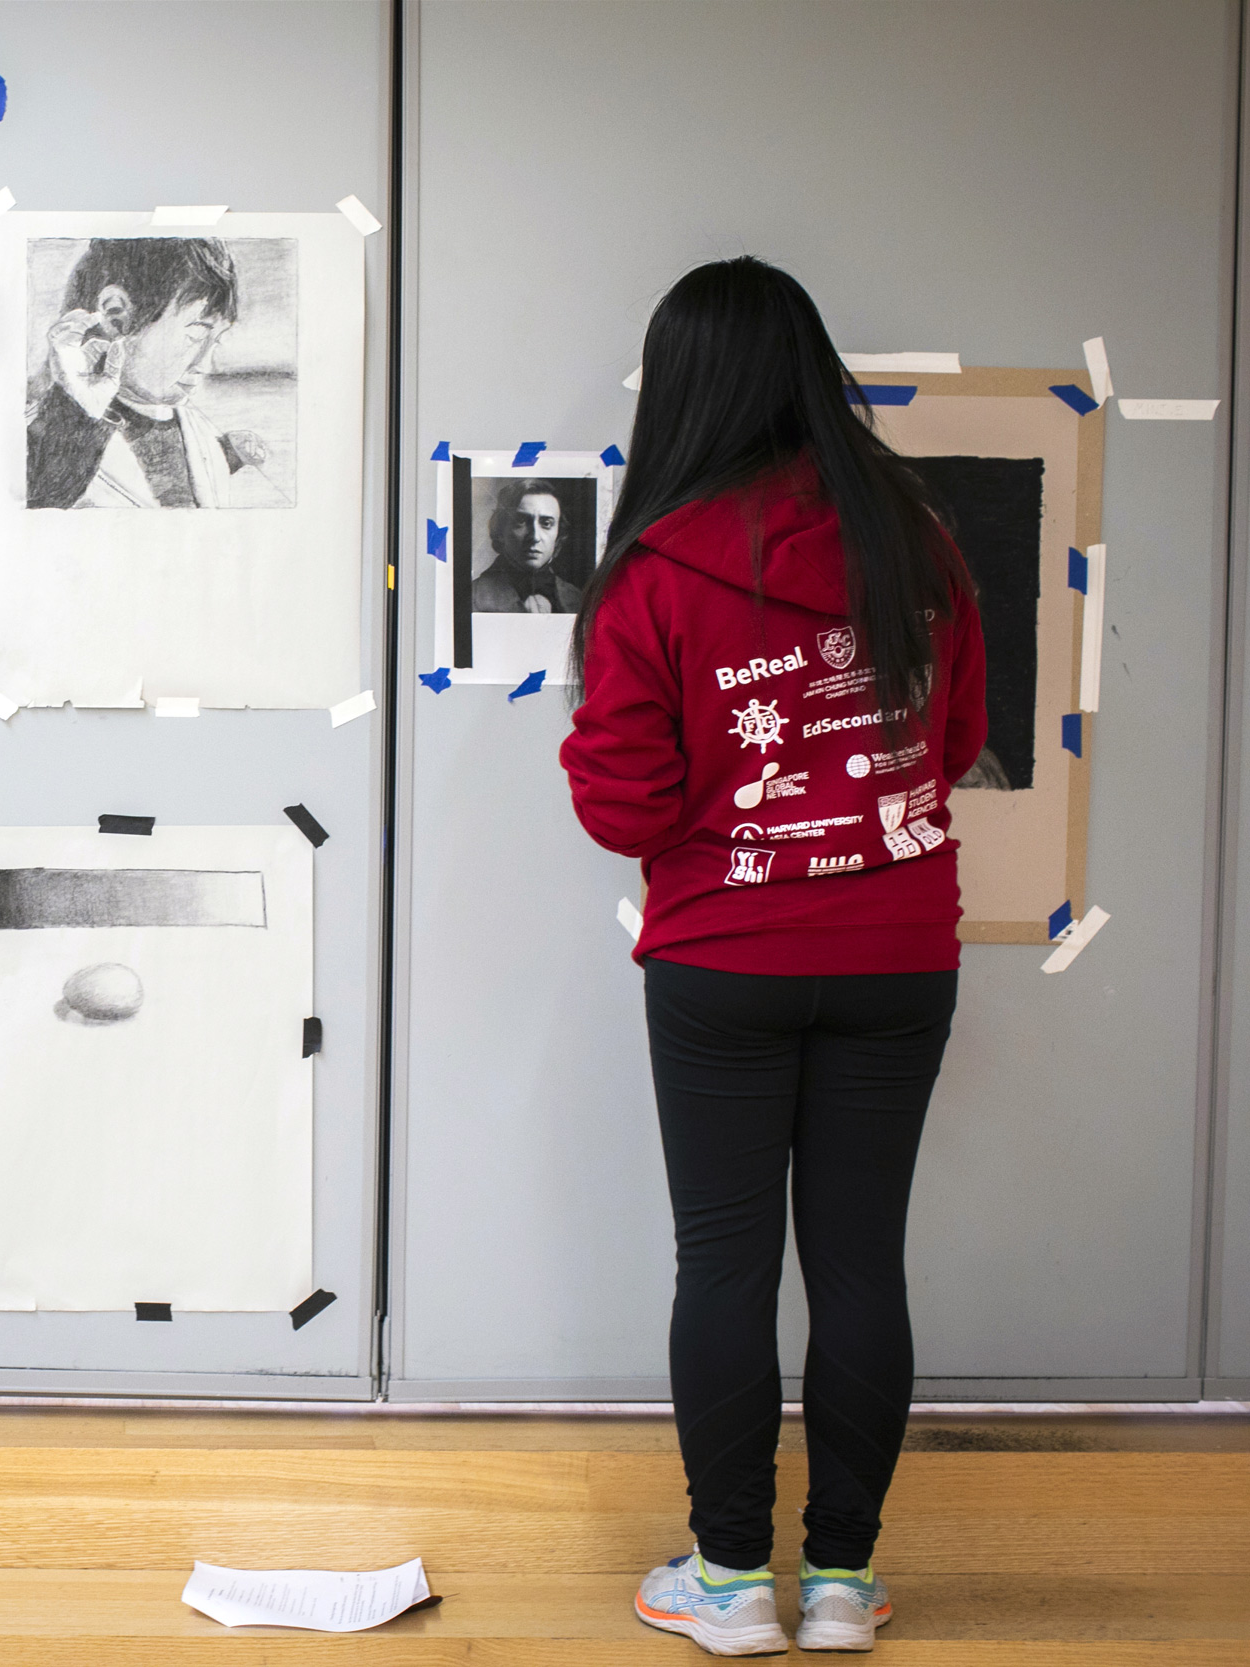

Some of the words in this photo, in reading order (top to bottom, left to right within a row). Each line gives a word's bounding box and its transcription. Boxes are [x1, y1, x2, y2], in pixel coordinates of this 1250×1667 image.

[715, 646, 808, 691] BeReal.
[766, 771, 810, 788] SINGAPORE
[766, 780, 796, 794] GLOBAL
[766, 786, 807, 800] NETWORK
[766, 821, 810, 835] HARVARD
[811, 814, 864, 828] UNIVERSITY
[790, 828, 826, 839] CENTER
